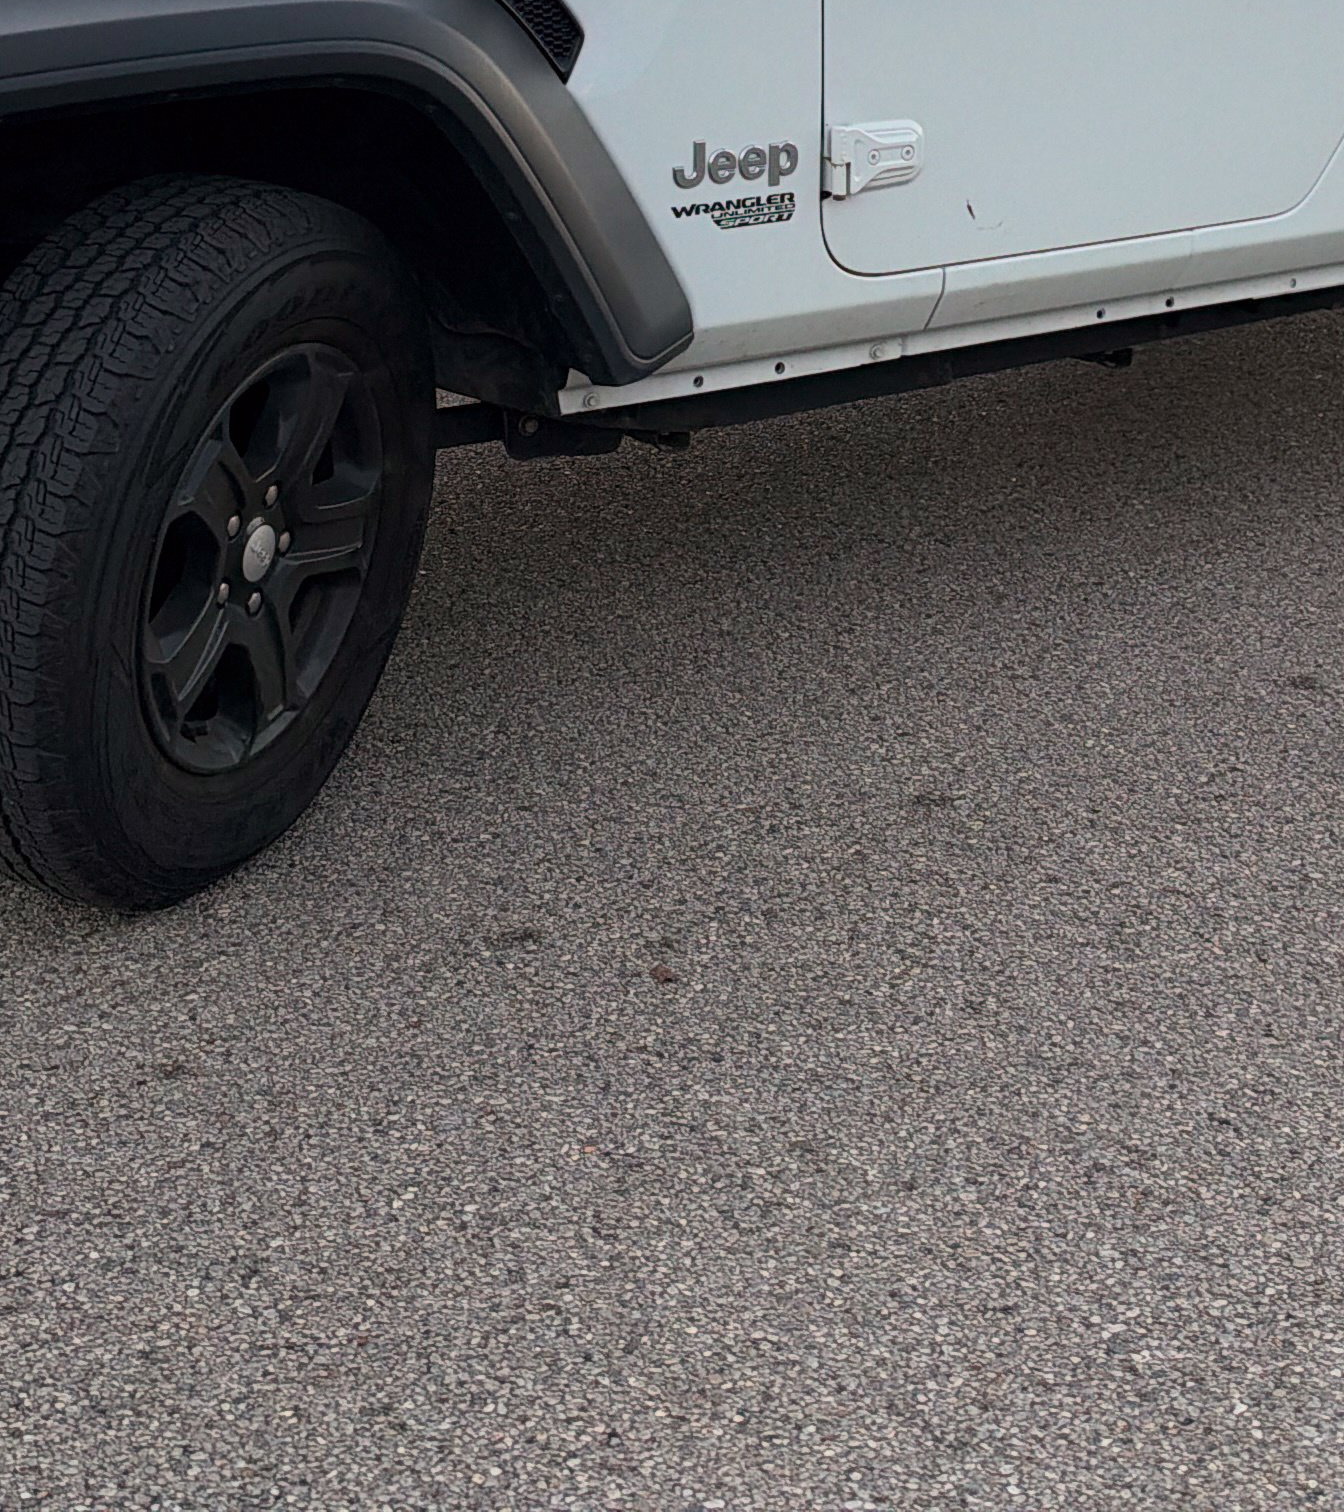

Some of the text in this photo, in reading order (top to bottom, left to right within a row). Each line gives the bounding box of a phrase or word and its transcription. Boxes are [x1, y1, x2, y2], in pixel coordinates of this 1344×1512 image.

[672, 139, 799, 190] Jeep
[670, 192, 796, 219] WRANGLER
[710, 202, 796, 220] UNLIMITED
[719, 213, 794, 227] SPORT
